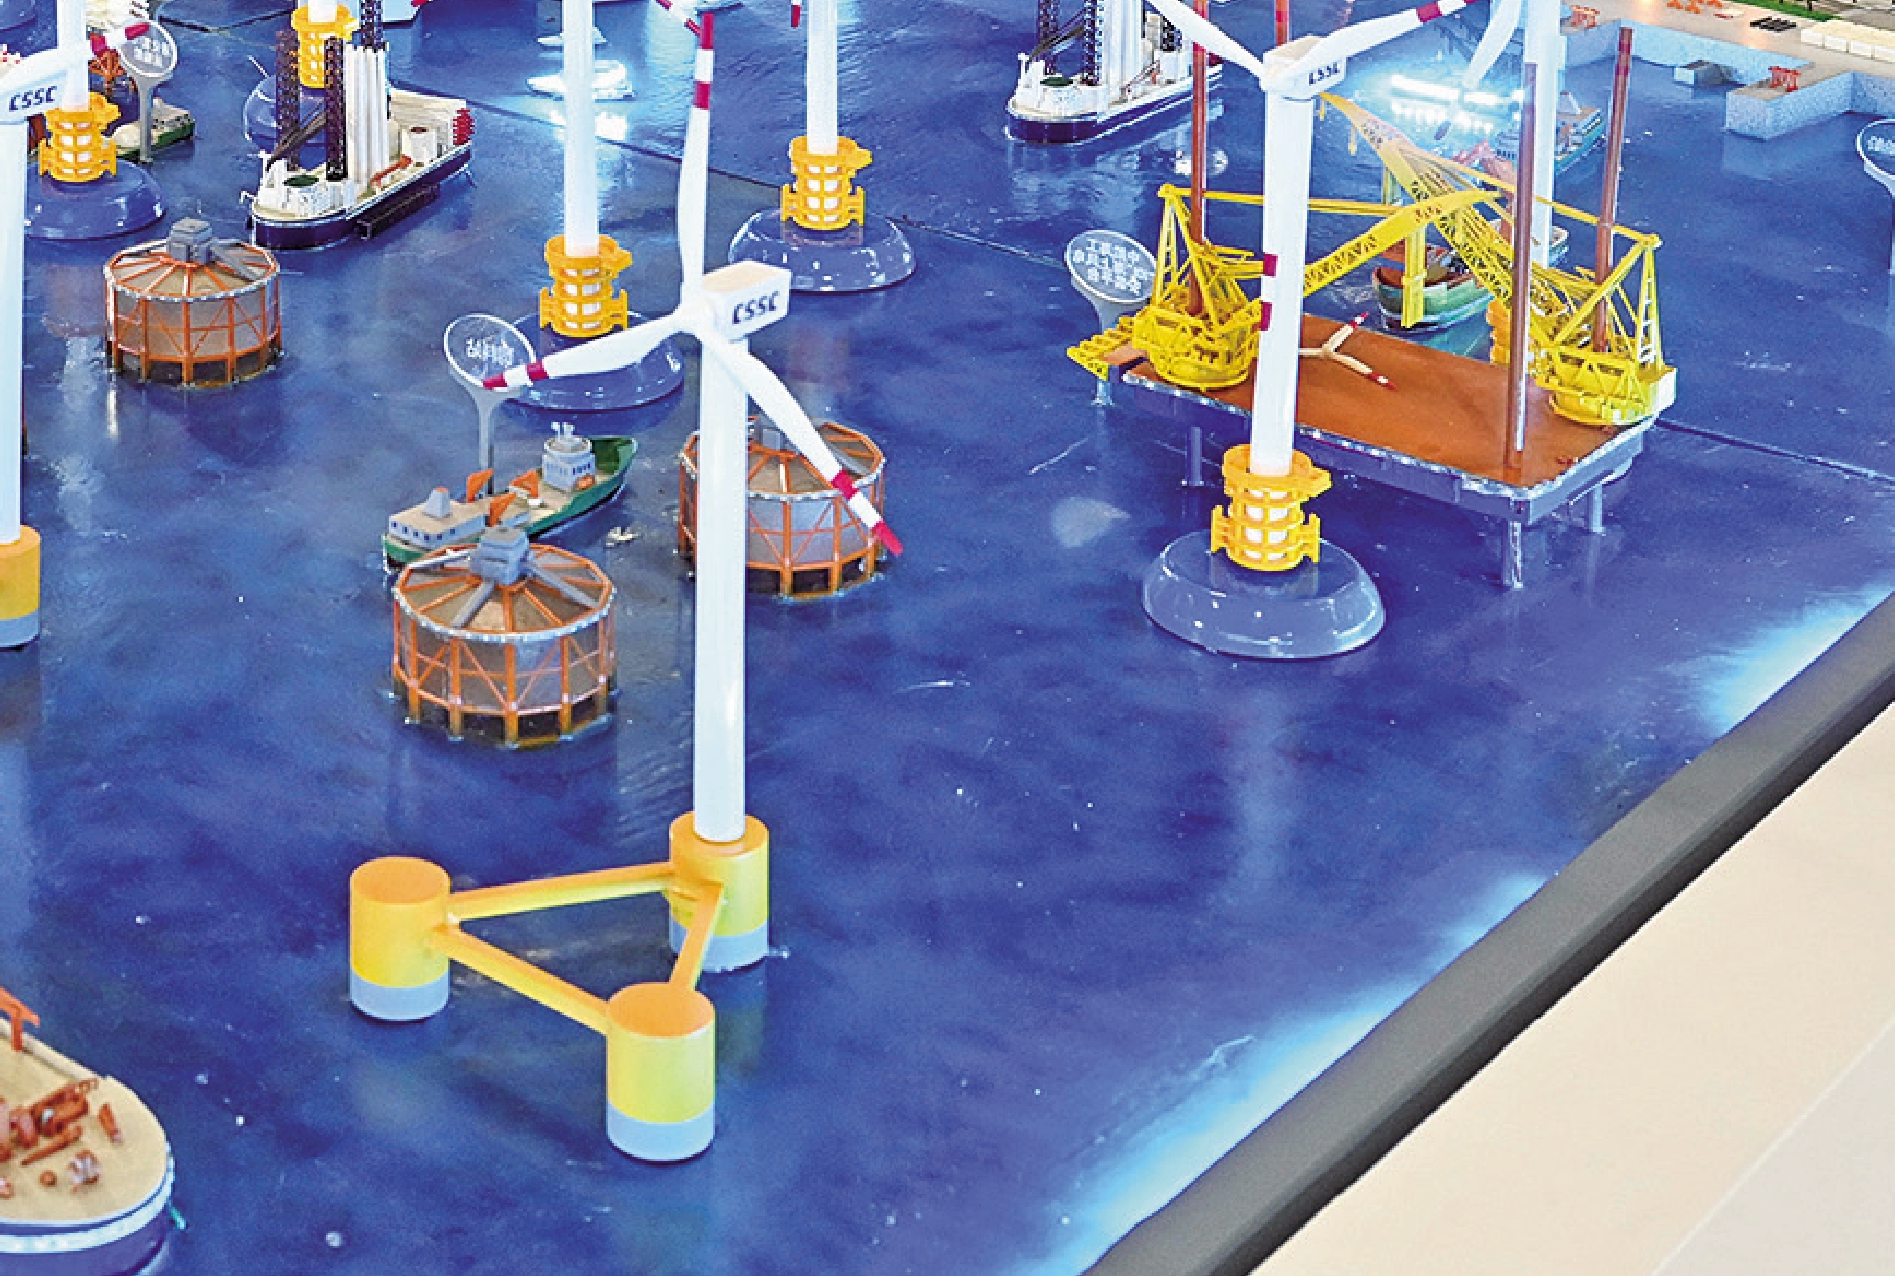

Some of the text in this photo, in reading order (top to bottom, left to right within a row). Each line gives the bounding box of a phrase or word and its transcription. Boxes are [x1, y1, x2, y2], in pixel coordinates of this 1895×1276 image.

[1309, 61, 1342, 87] CSSC
[8, 85, 58, 111] CSSC
[731, 289, 781, 326] CSSC
